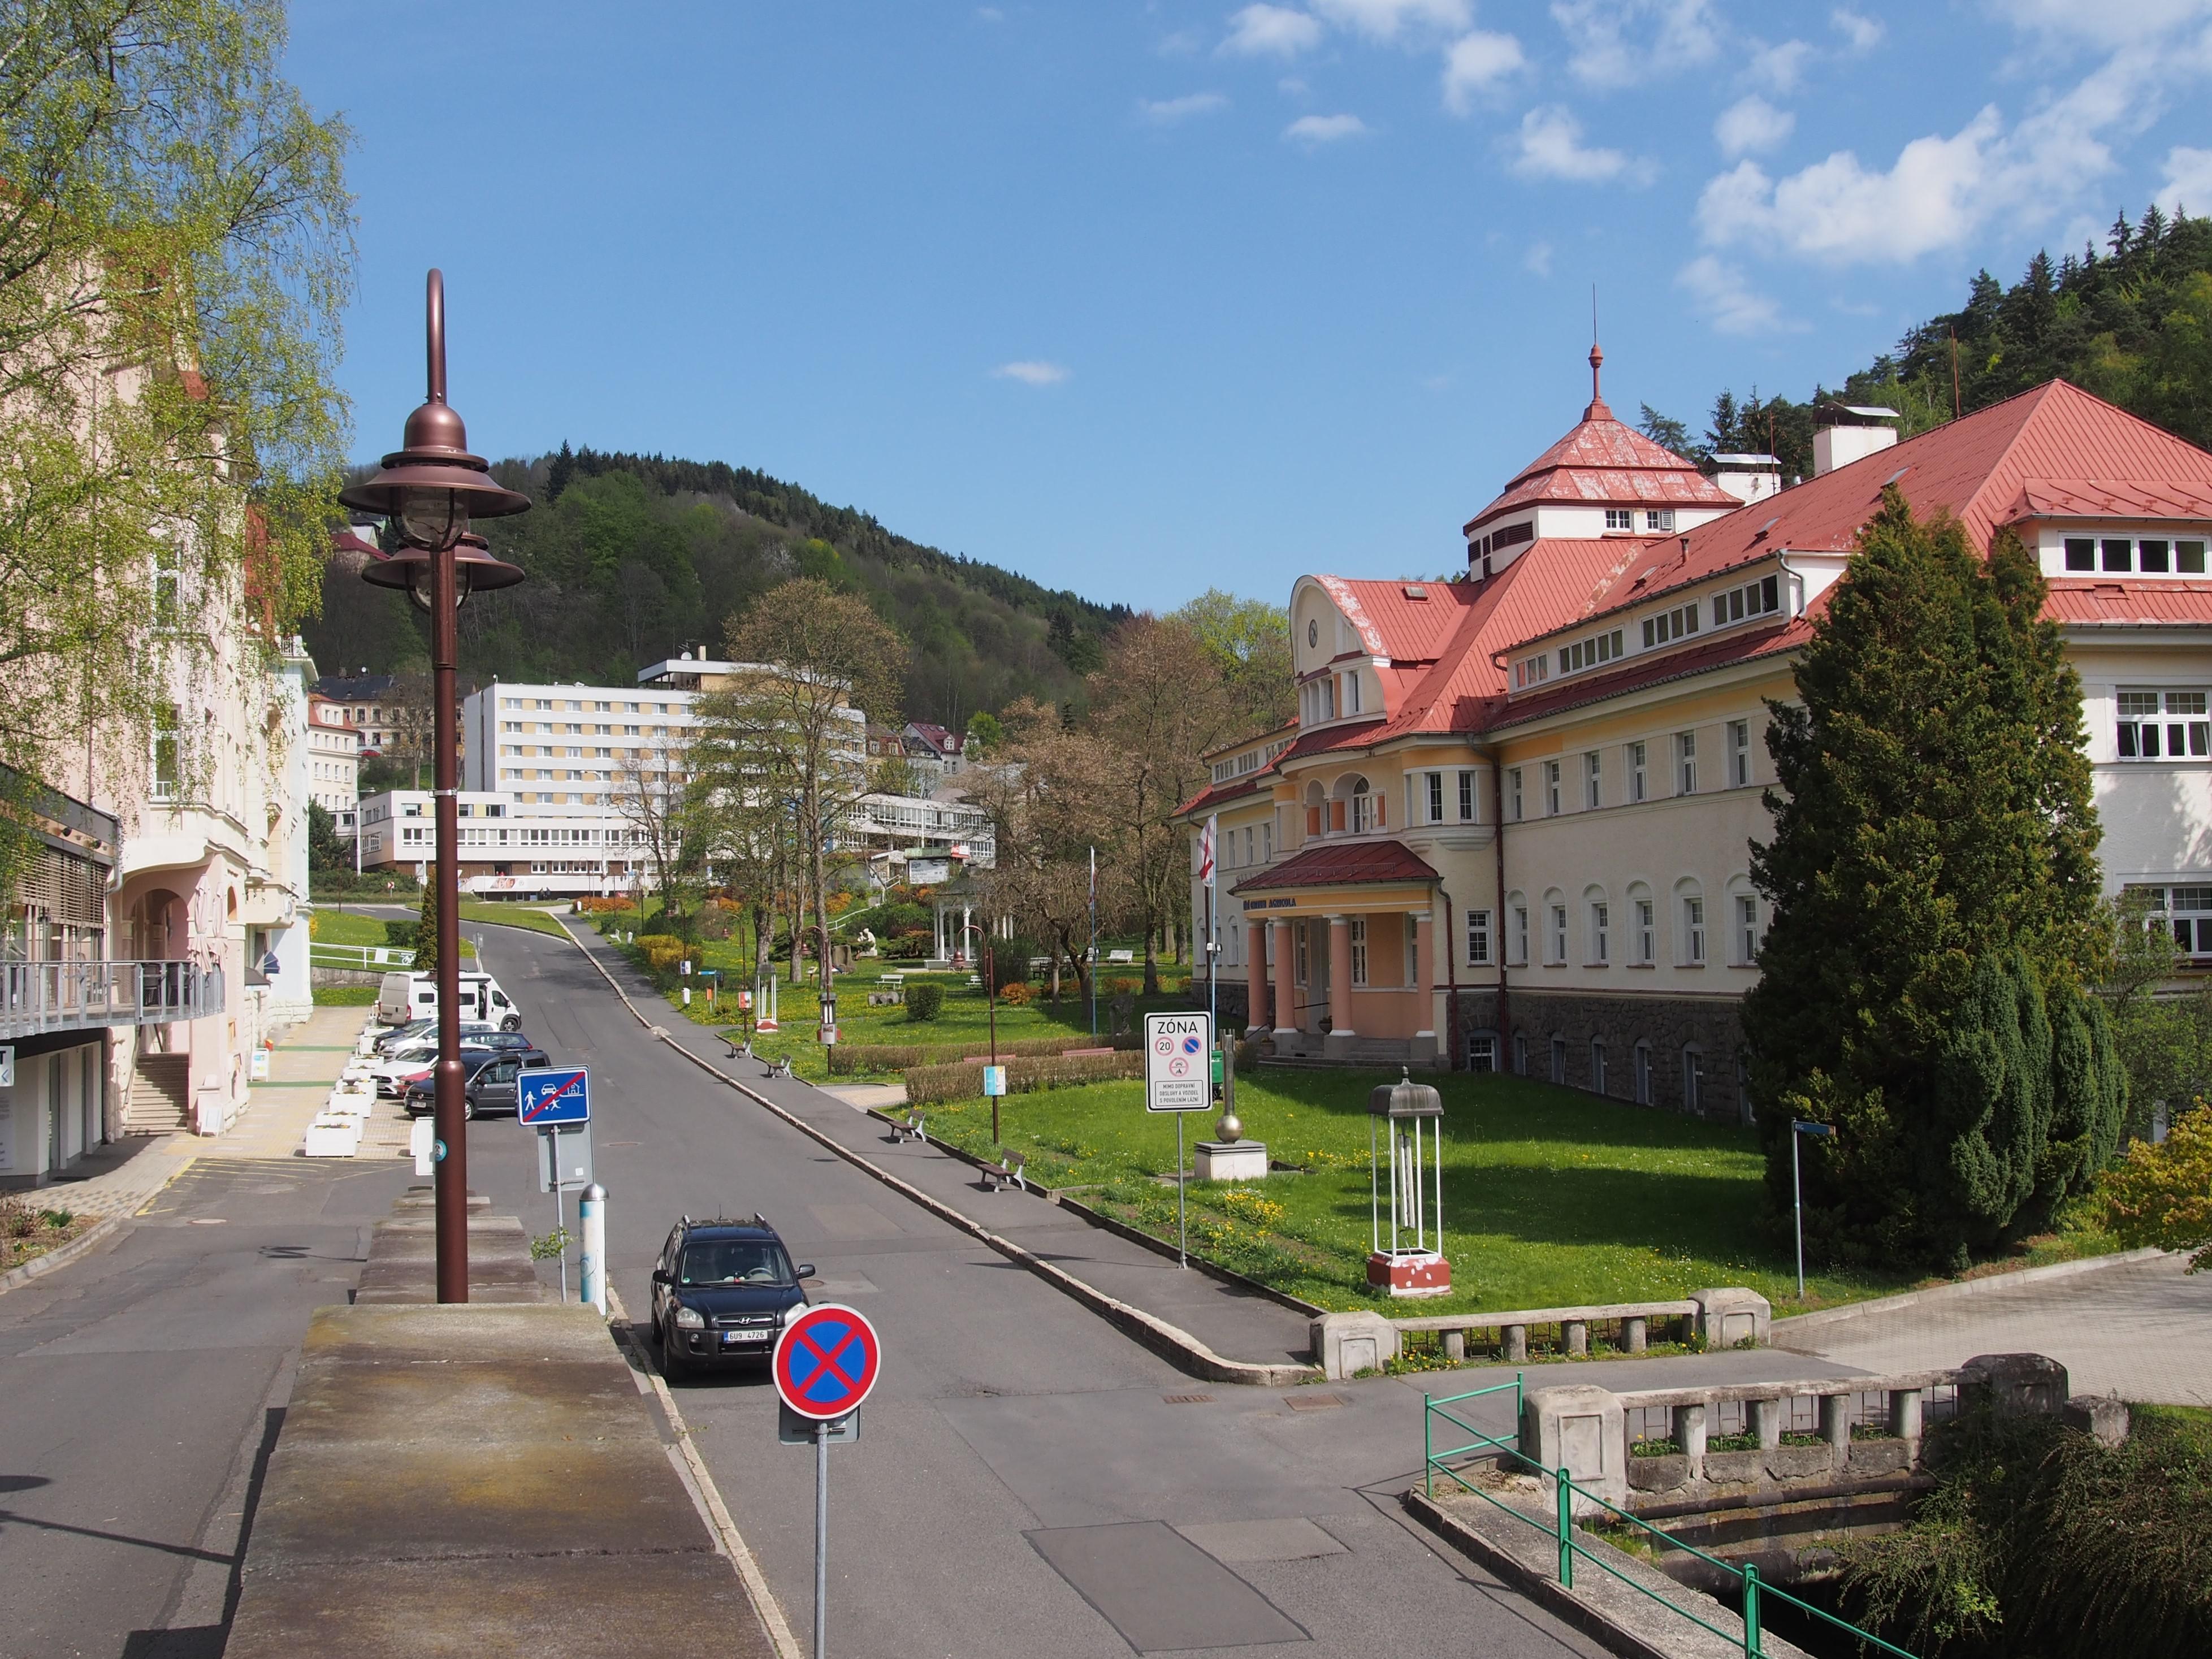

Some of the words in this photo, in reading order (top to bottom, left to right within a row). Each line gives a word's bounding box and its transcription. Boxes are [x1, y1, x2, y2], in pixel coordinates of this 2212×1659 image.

[1269, 898, 1296, 908] AGRICOLA
[1157, 1019, 1198, 1034] ZÓNA
[1159, 1042, 1170, 1050] 20
